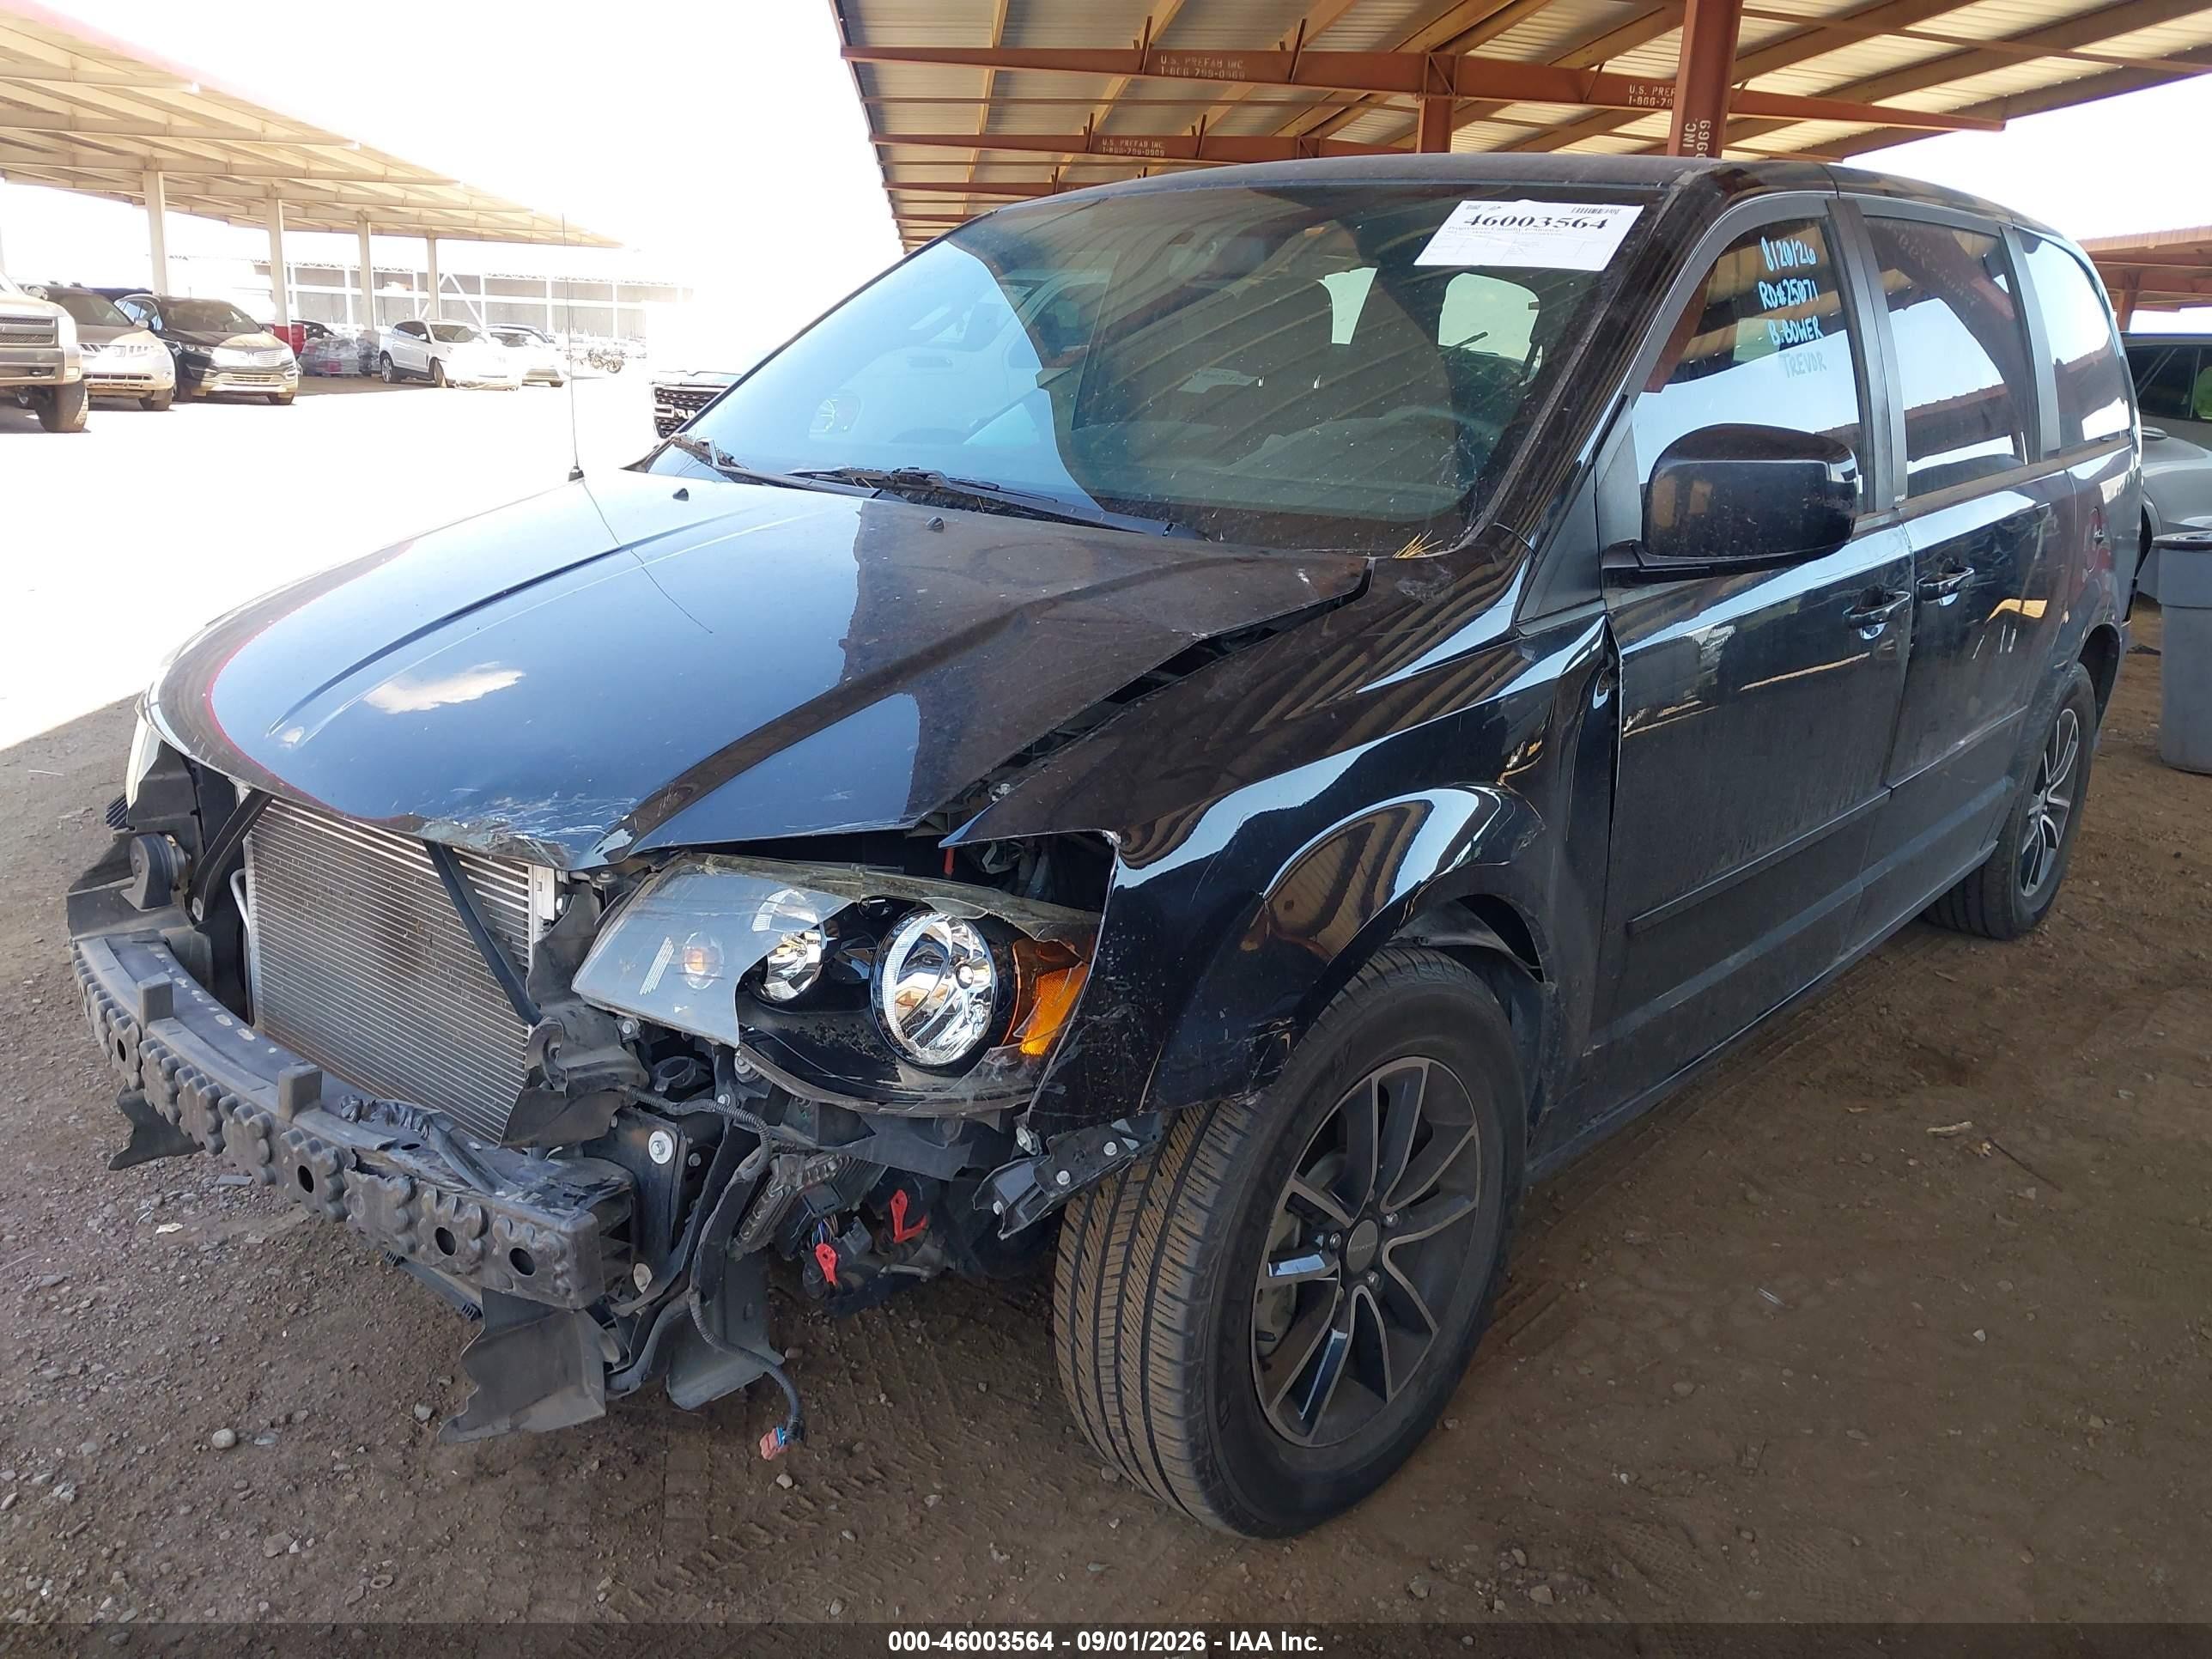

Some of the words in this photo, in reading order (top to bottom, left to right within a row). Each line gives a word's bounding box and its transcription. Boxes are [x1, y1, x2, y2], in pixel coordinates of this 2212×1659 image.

[1628, 84, 1648, 95] U.S.
[1682, 118, 1698, 149] INC.
[1463, 213, 1609, 230] 46003564
[1760, 235, 1818, 271] 8/20/26
[1778, 350, 1828, 379] TREVOR
